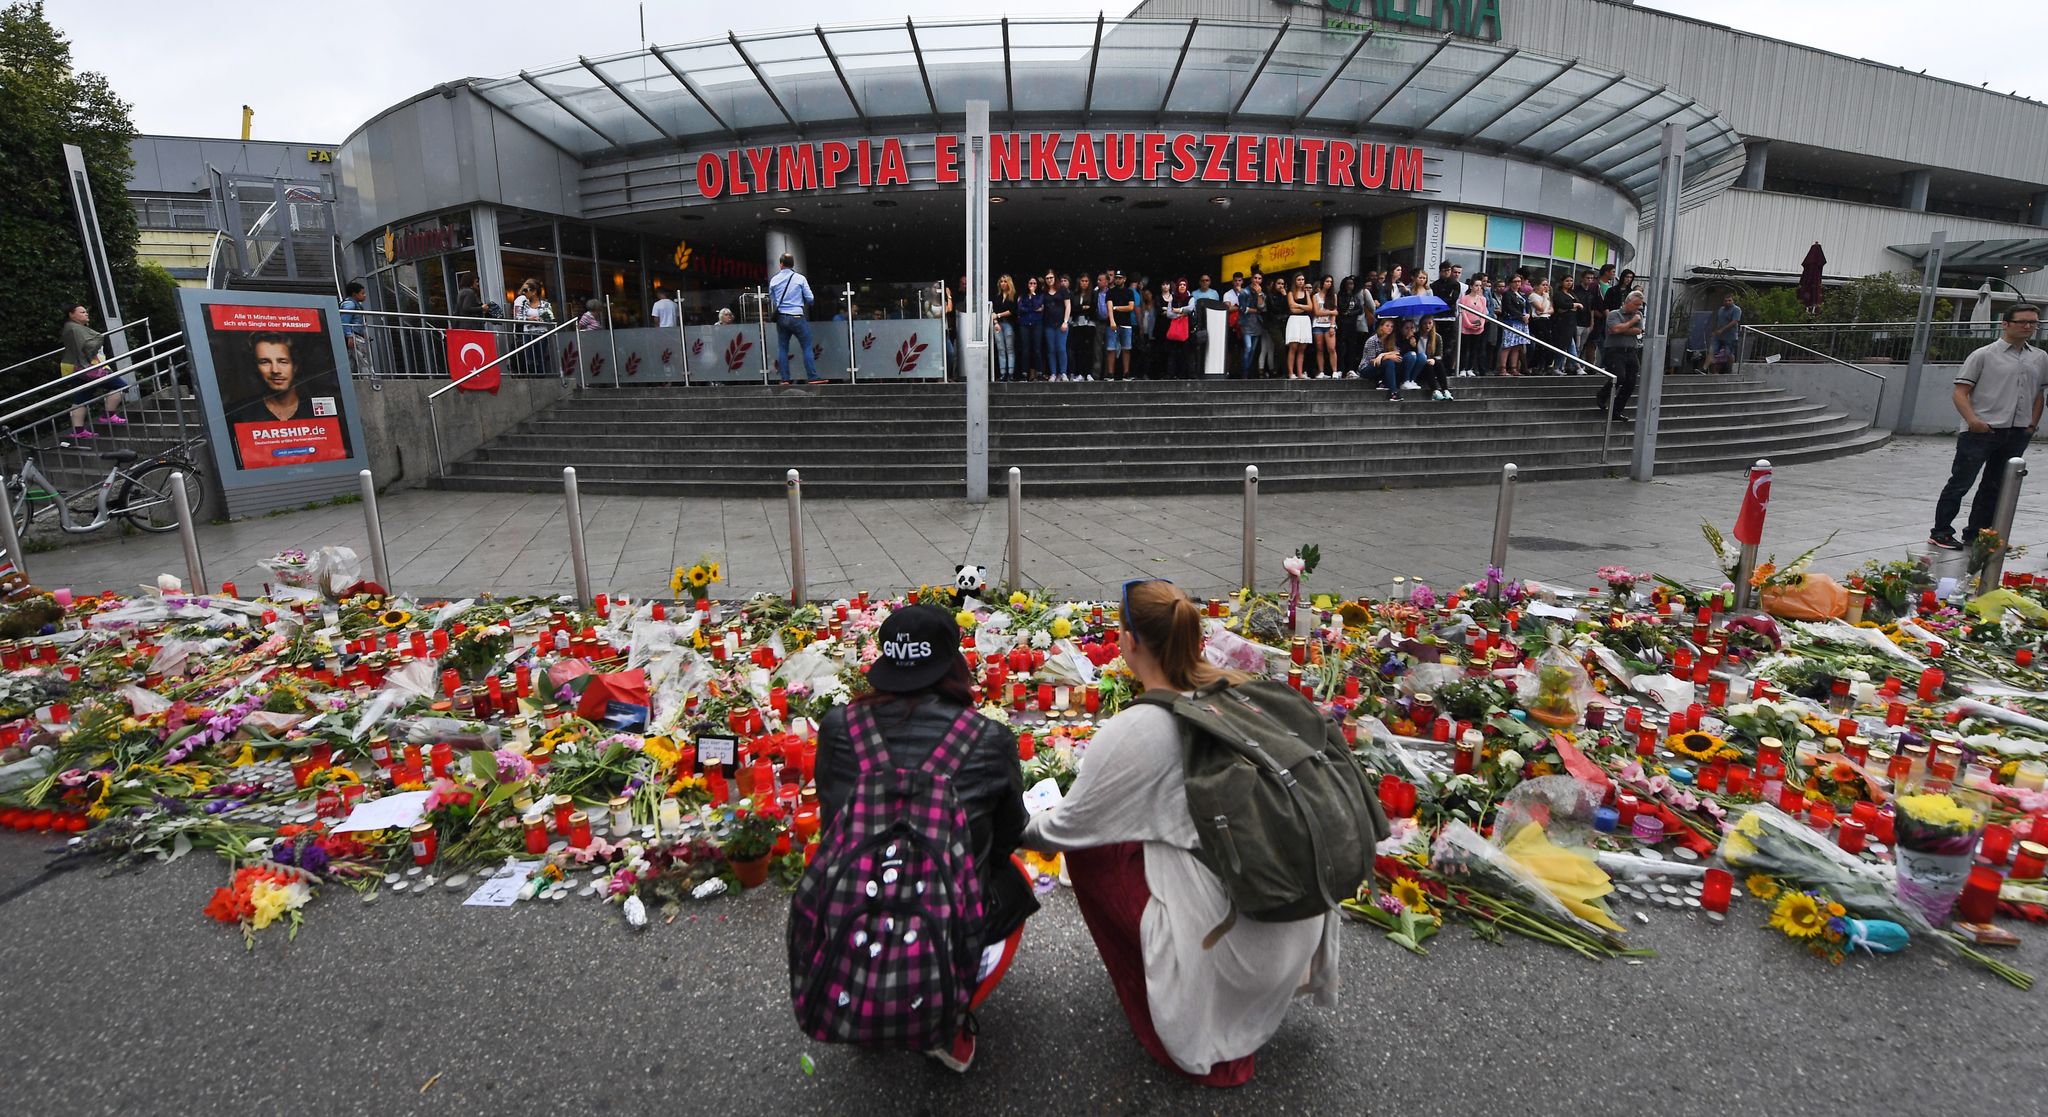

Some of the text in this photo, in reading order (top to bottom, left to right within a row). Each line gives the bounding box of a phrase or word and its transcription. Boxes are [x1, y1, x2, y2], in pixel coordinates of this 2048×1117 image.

[695, 132, 1424, 199] OLYMPIA ENKAUFSZENTRUM
[1429, 213, 1440, 270] Konditorei
[252, 426, 326, 440] PARSHIP.de
[883, 640, 932, 660] GIVES
